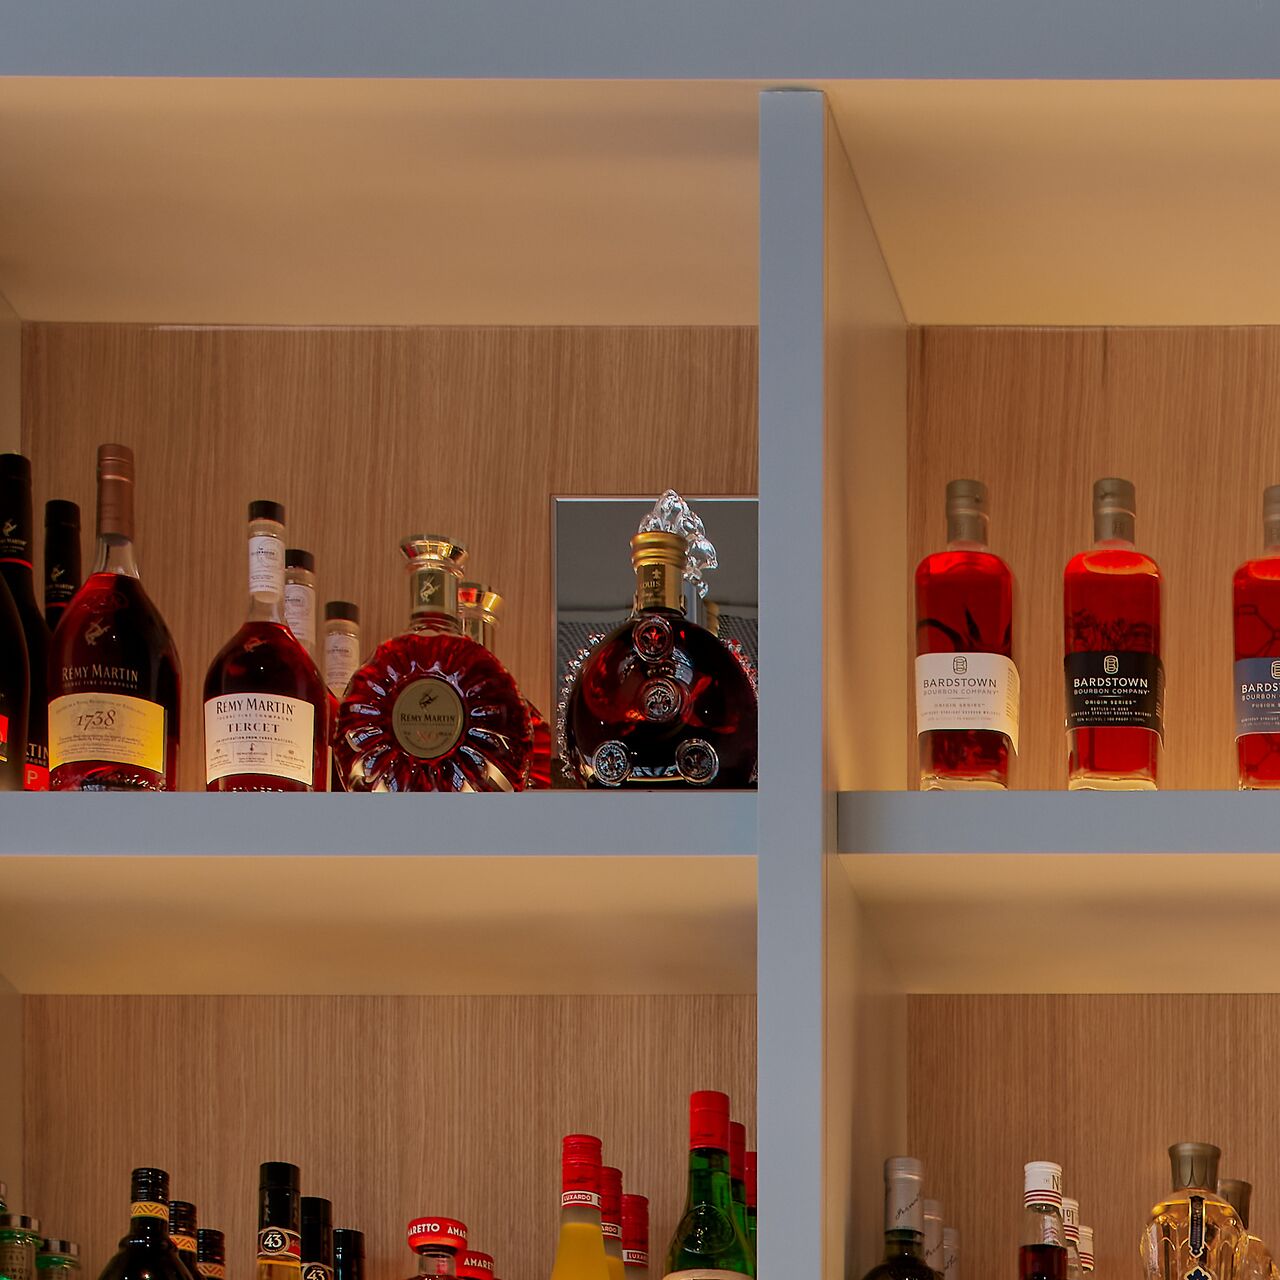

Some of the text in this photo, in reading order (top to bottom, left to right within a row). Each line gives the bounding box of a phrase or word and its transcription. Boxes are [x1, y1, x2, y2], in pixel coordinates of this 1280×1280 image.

[923, 677, 997, 689] BARDSTOWN
[1073, 677, 1148, 689] BARDSTOWN
[77, 709, 116, 731] 1738
[227, 722, 280, 733] TERCET
[563, 1193, 591, 1202] LUXARDO
[264, 1235, 282, 1247] 43
